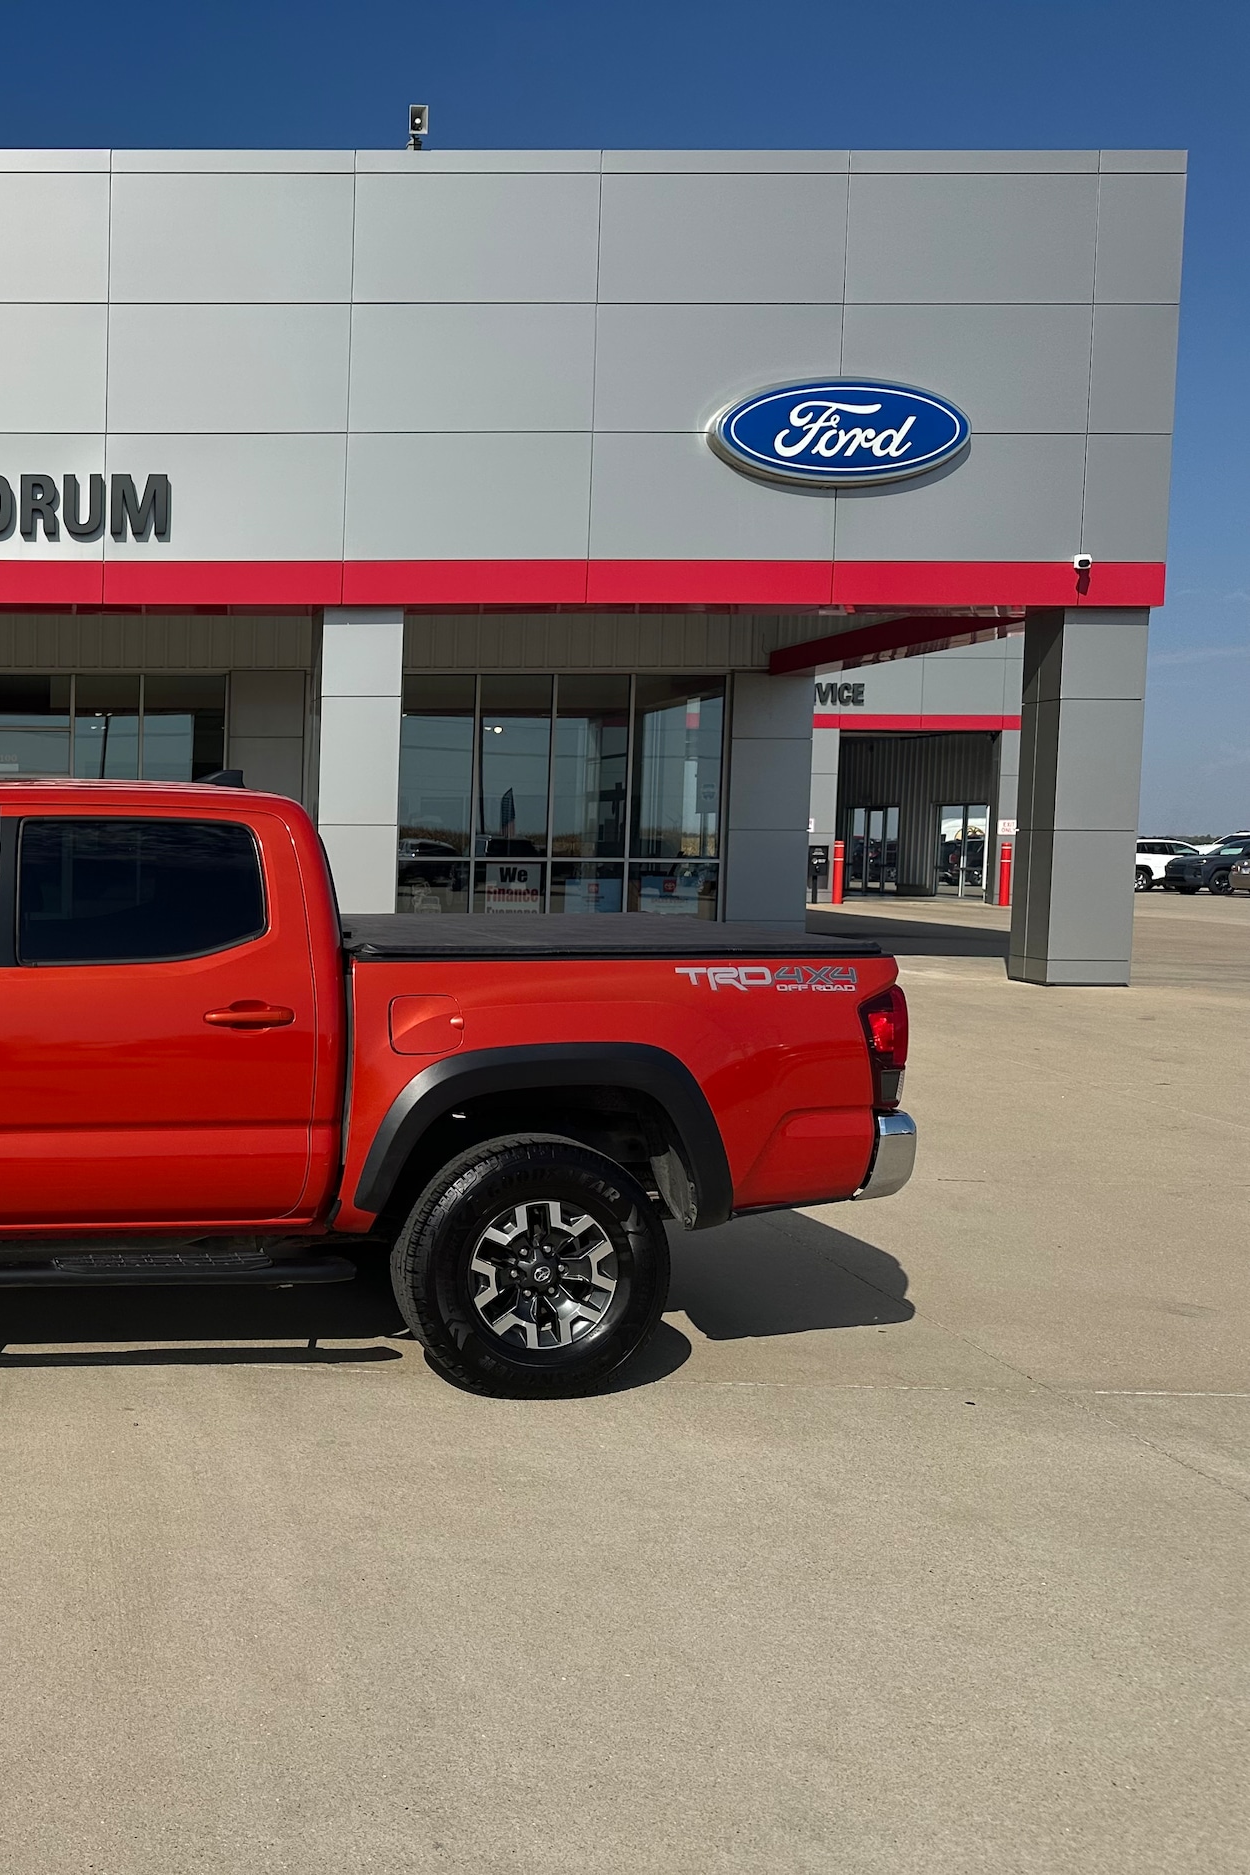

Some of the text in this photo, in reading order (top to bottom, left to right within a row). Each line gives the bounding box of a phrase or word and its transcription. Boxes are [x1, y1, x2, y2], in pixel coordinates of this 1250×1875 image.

[774, 400, 918, 458] Ford
[814, 682, 865, 706] VICE
[499, 866, 528, 883] We
[486, 885, 539, 903] Finance
[675, 965, 858, 992] TRD 4X4
[776, 983, 857, 992] OFF ROAD
